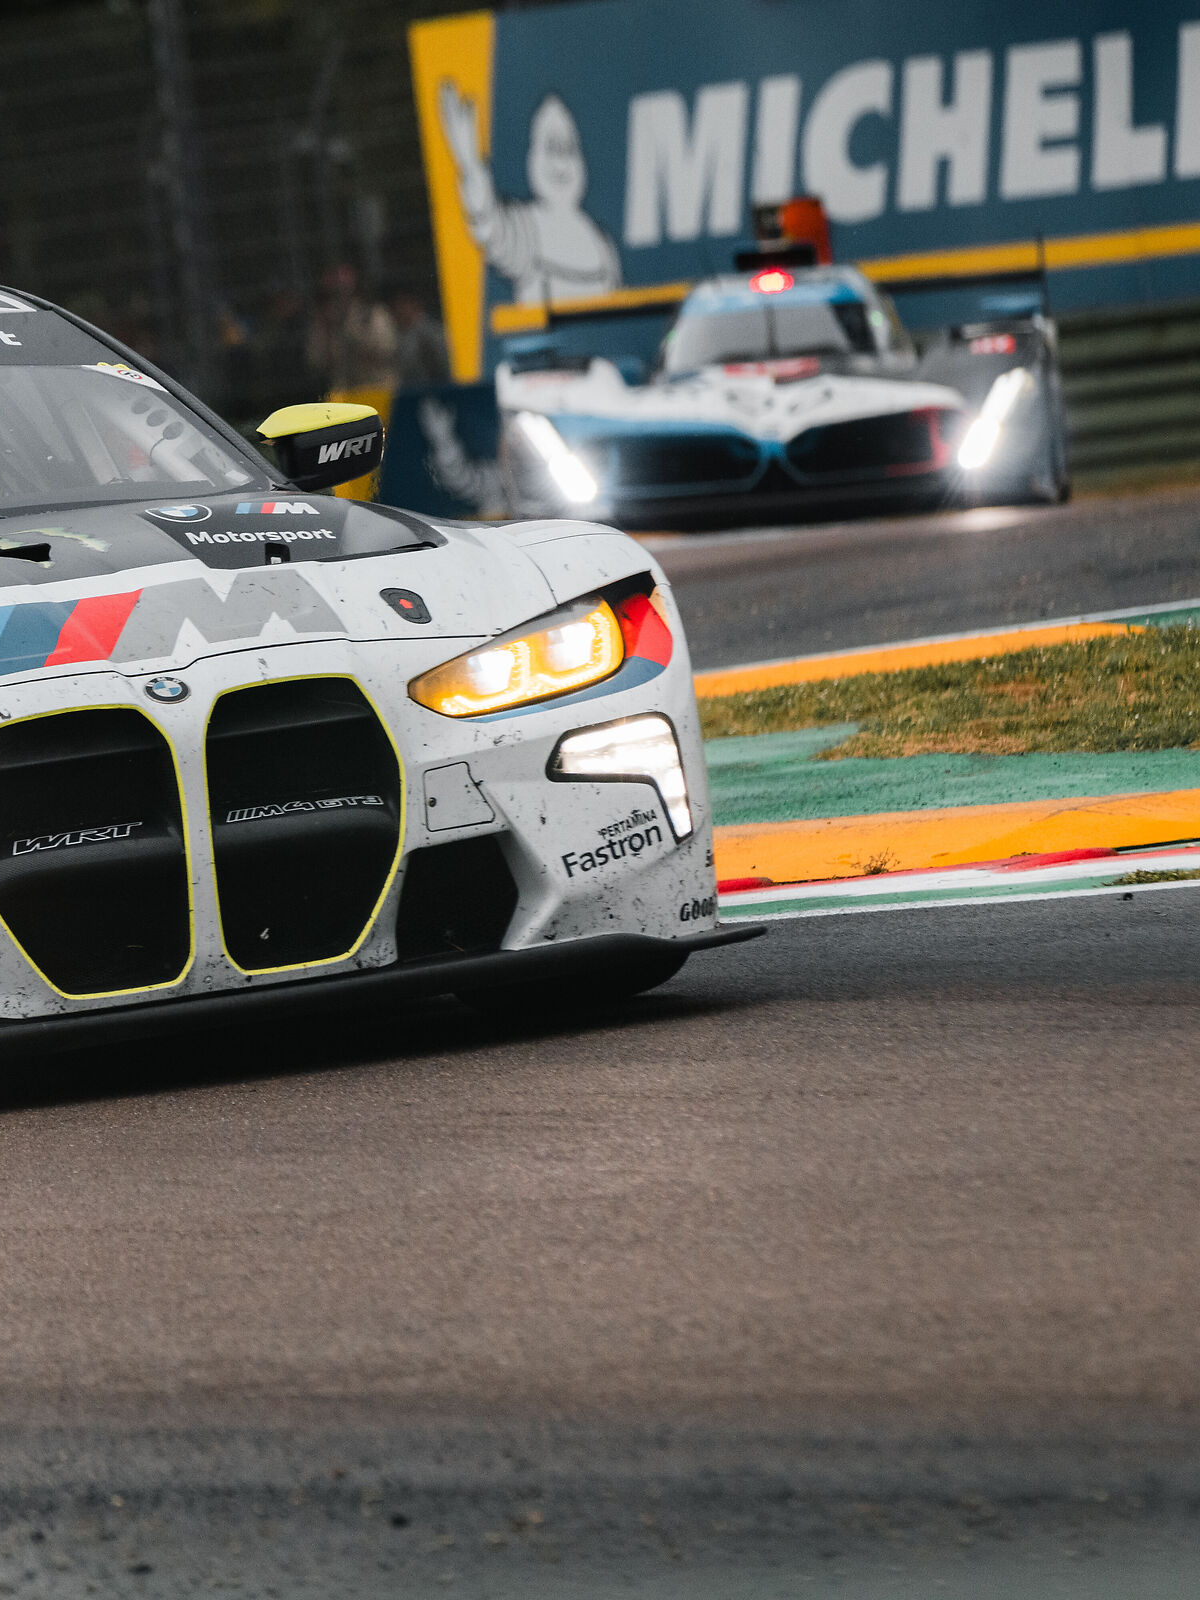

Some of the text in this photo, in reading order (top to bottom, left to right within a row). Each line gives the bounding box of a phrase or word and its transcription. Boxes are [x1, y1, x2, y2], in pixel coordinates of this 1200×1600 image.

[317, 432, 378, 464] WRT
[184, 528, 337, 545] Motorsport
[314, 795, 384, 809] GT3
[12, 821, 142, 855] WRT
[600, 809, 658, 839] PERTAMINA
[561, 825, 663, 878] Fastron
